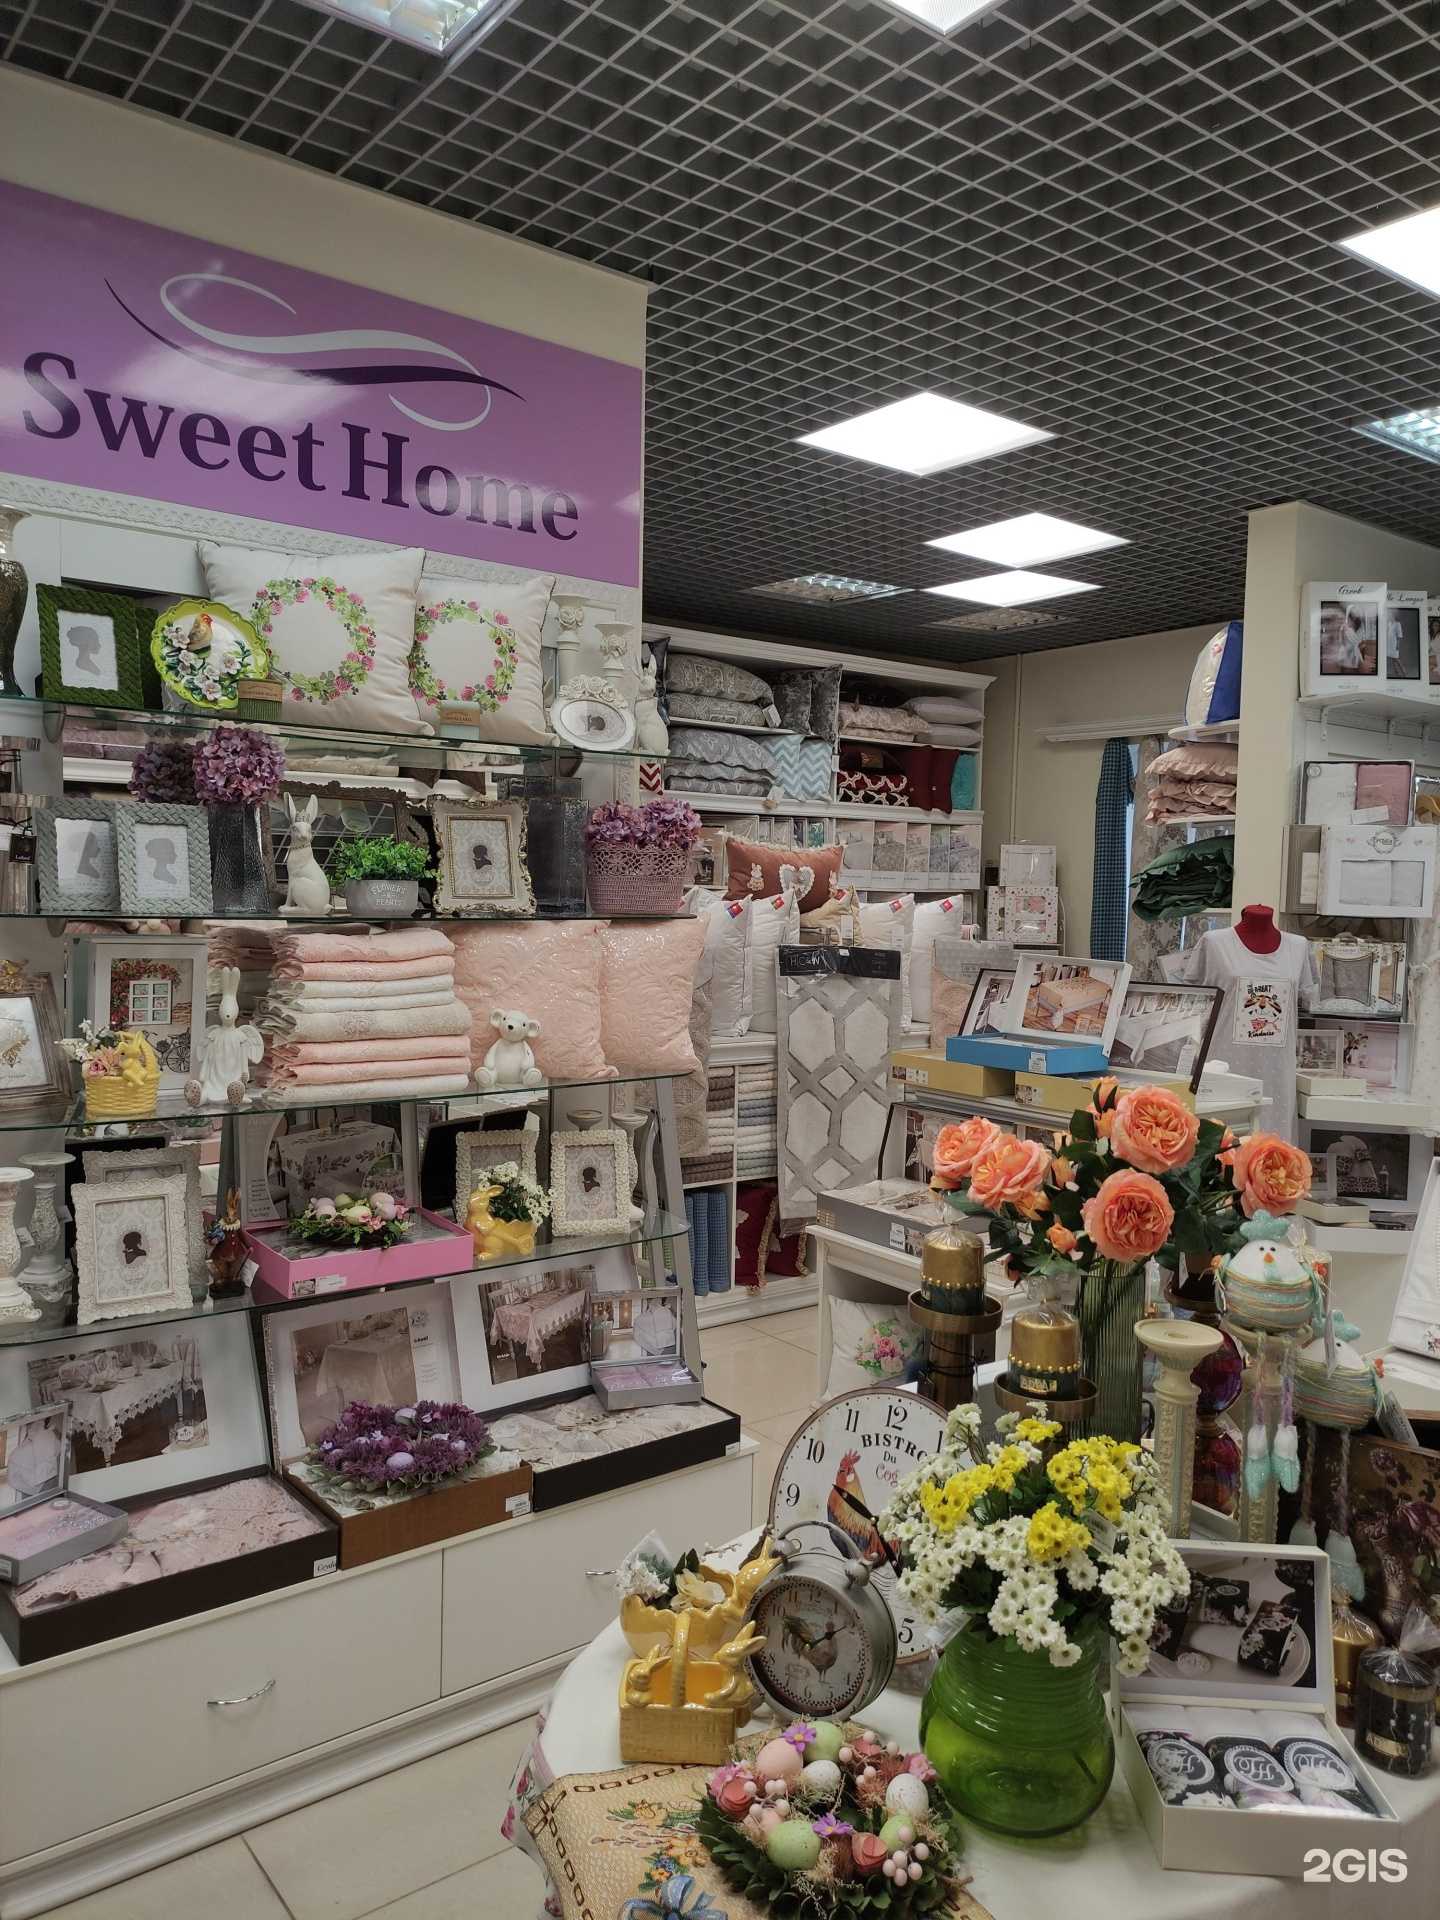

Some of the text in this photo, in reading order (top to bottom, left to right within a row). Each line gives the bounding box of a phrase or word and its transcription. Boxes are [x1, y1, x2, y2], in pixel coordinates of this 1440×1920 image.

[846, 1408, 860, 1433] 11
[885, 1405, 908, 1431] 12
[806, 1438, 825, 1464] 10
[883, 1451, 897, 1464] Du
[786, 1483, 800, 1507] 9
[898, 1618, 915, 1644] 5
